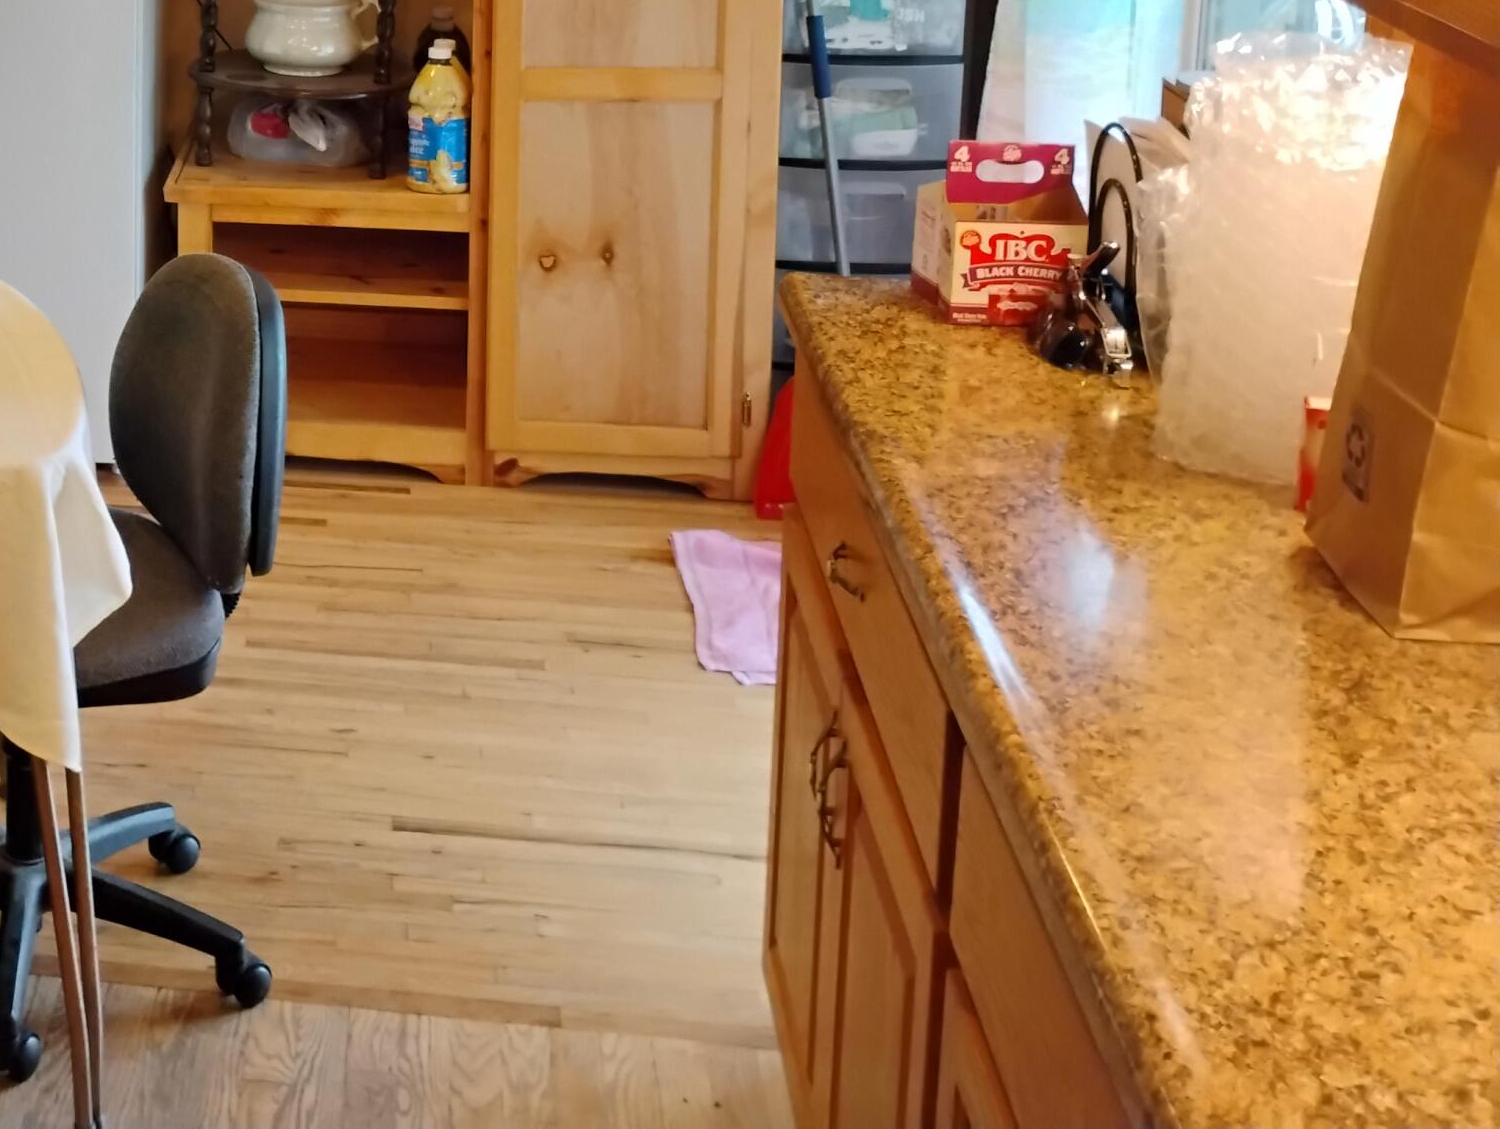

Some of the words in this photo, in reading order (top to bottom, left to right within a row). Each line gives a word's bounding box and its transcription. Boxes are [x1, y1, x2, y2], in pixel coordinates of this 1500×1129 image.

[954, 145, 970, 162] 4
[1054, 147, 1069, 164] 4
[994, 239, 1048, 261] IBC
[975, 266, 1015, 280] BLACK
[1017, 266, 1063, 280] CHERRY
